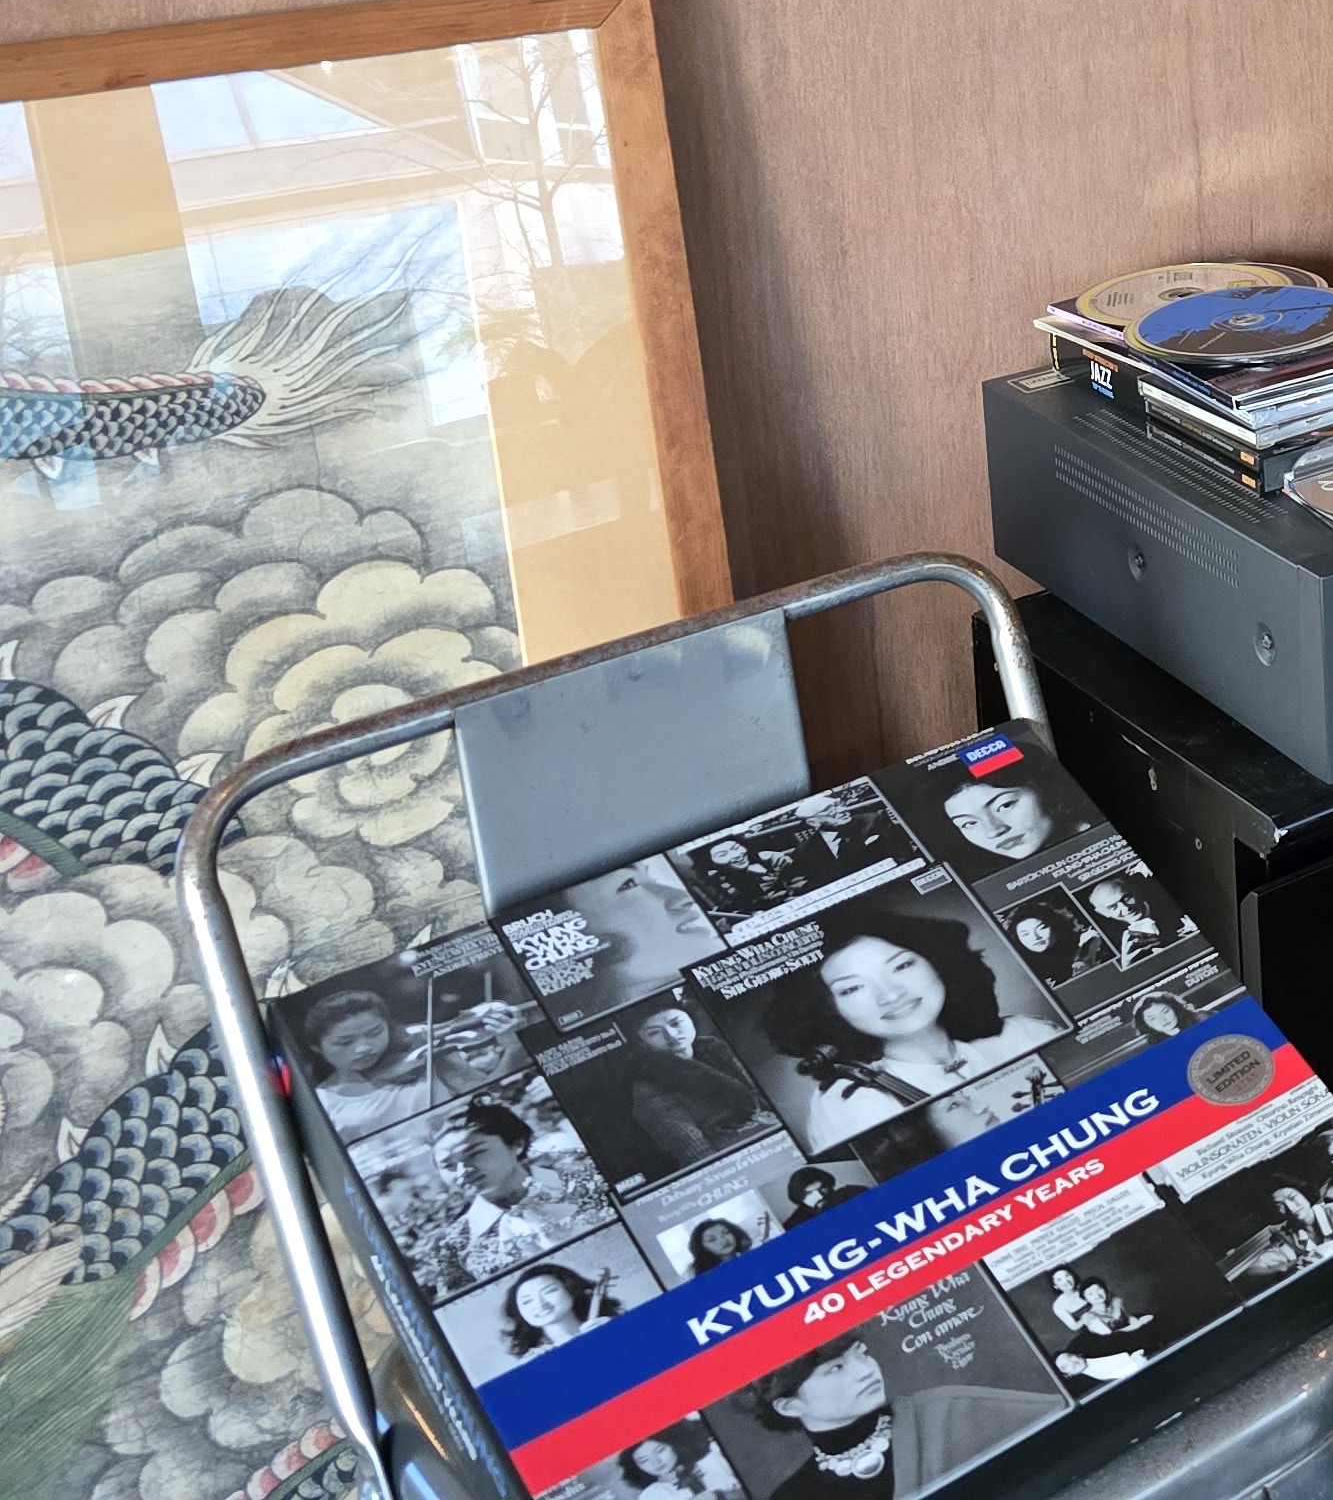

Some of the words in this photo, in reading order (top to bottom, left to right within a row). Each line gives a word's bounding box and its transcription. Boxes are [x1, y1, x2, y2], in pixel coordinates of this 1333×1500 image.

[1090, 360, 1113, 389] JAZZ
[966, 740, 1006, 762] DECCA
[502, 909, 553, 937] BRUCH
[1206, 1050, 1252, 1084] LIMITED
[1214, 1058, 1261, 1093] EDITION
[1264, 1105, 1301, 1131] VIOLIN
[687, 1174, 1000, 1345] KYUNG-WHA
[1001, 1088, 1159, 1182] CHUNG
[803, 1291, 846, 1324] 40
[853, 1204, 1013, 1300] LEGENDARY
[1014, 1157, 1105, 1209] YEARS
[902, 1327, 933, 1353] Con
[934, 1305, 985, 1337] amore
